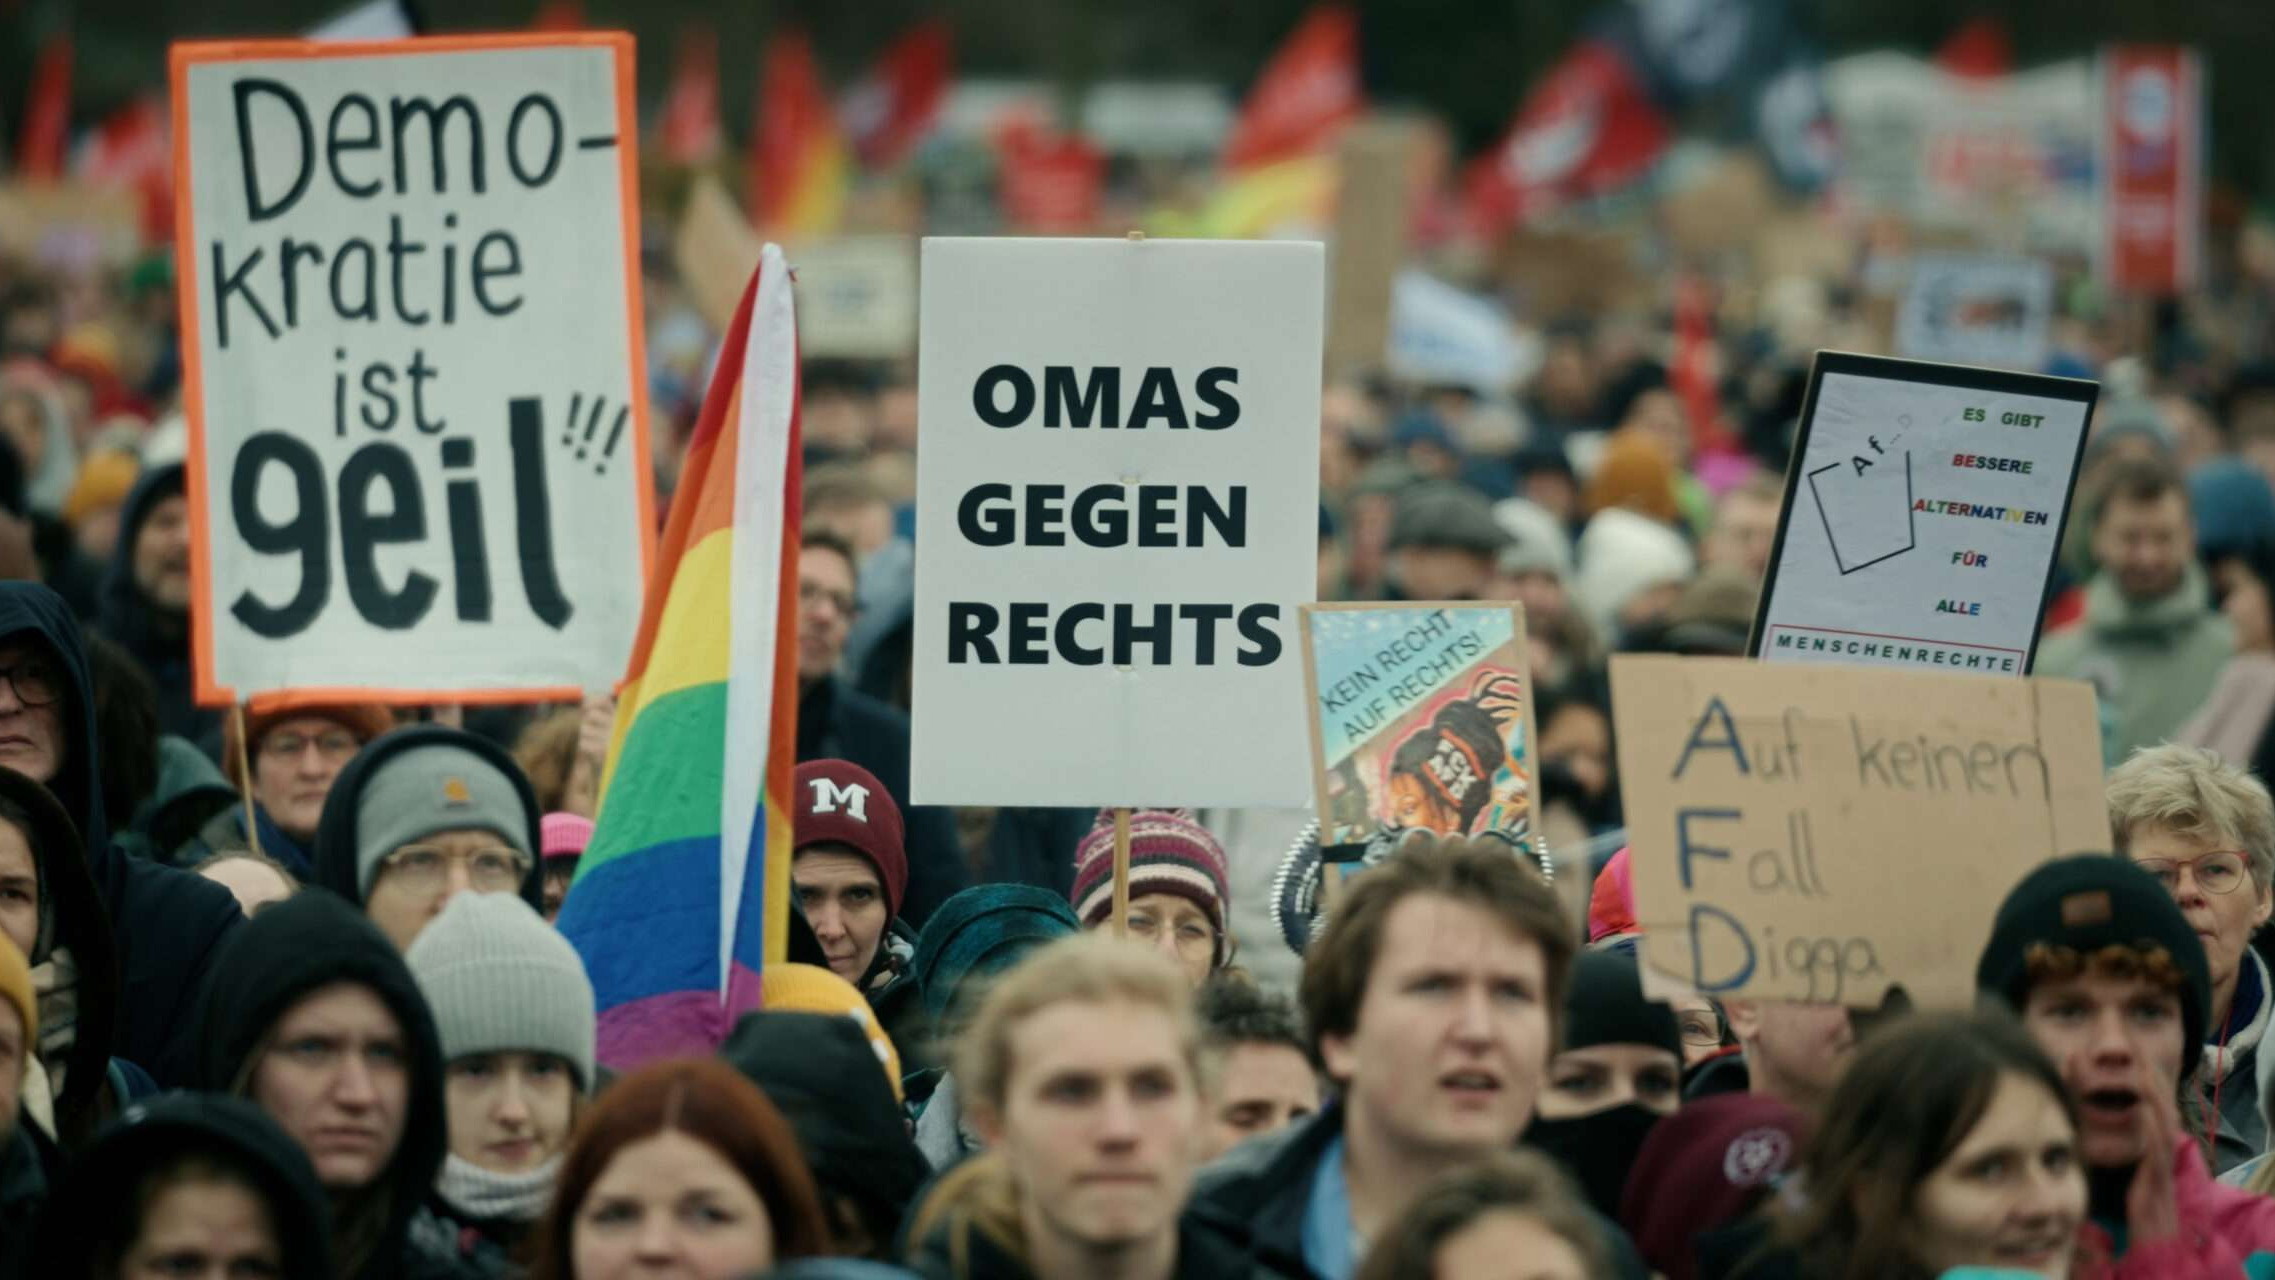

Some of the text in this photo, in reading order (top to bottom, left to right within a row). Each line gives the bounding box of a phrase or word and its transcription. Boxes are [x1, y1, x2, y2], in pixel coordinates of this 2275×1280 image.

[233, 77, 617, 222] Demo-
[333, 348, 446, 437] ist
[972, 364, 1241, 430] OMAS
[1962, 407, 2045, 429] ES GIBT
[1952, 454, 2034, 474] BESSERE
[957, 483, 1247, 548] GEGEN
[1912, 499, 2048, 526] ALTERNATIVEN
[1952, 550, 1988, 568] FÜR
[948, 602, 1283, 667] RECHTS
[1936, 599, 1981, 616] ALLE
[1320, 608, 1454, 714] KEIN RECHT
[1777, 634, 2014, 672] MENSCHENRECHTE
[1343, 629, 1486, 743] AUF RECHTS!
[1671, 696, 2052, 804] Auf keinen
[809, 777, 871, 823] M
[1675, 807, 1829, 899] Fall
[1689, 904, 1884, 1001] Digga
